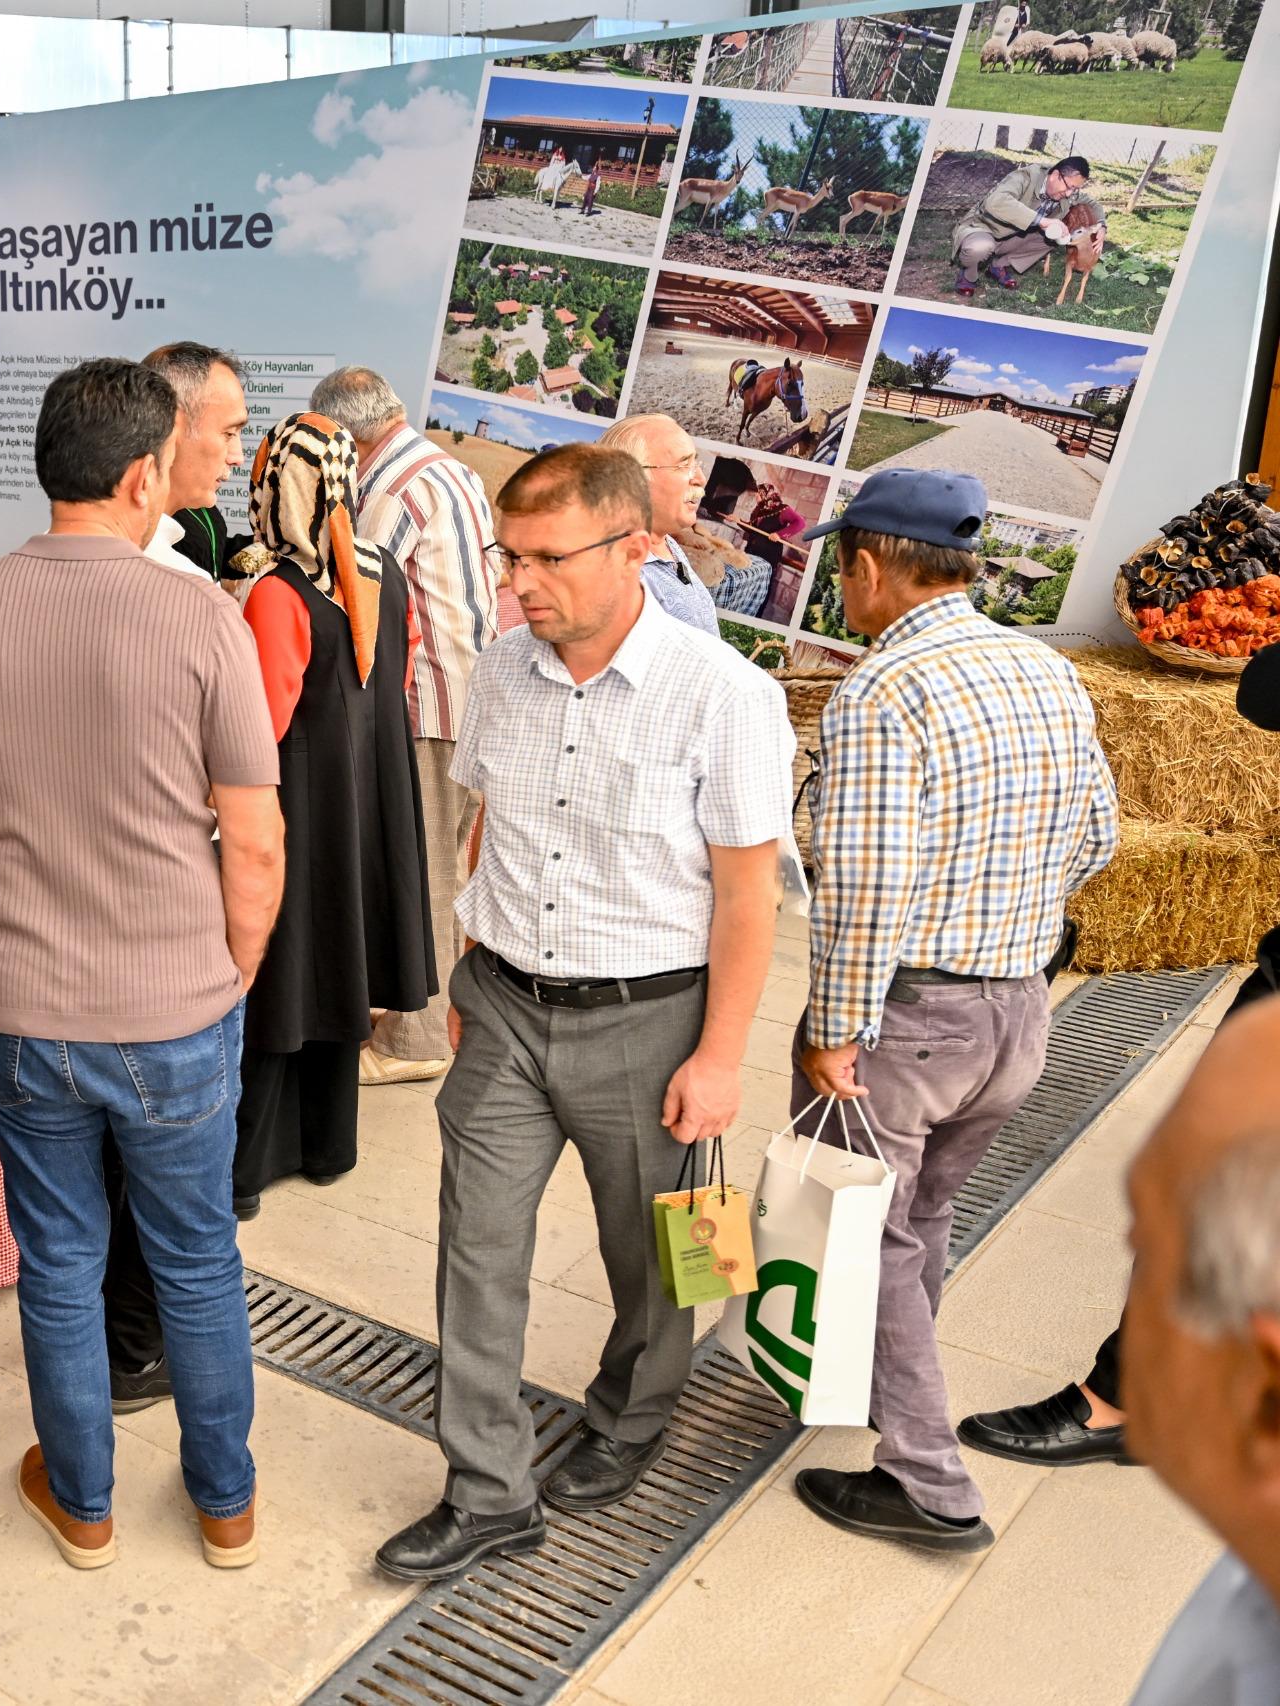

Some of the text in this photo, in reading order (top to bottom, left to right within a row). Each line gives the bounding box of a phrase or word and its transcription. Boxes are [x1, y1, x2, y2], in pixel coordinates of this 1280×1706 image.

[149, 202, 274, 252] müze
[16, 355, 35, 364] Hava
[244, 361, 313, 373] Köy Hayvanları
[247, 380, 283, 393] Ürünleri
[16, 425, 35, 433] 1500
[6, 438, 21, 448] Açık
